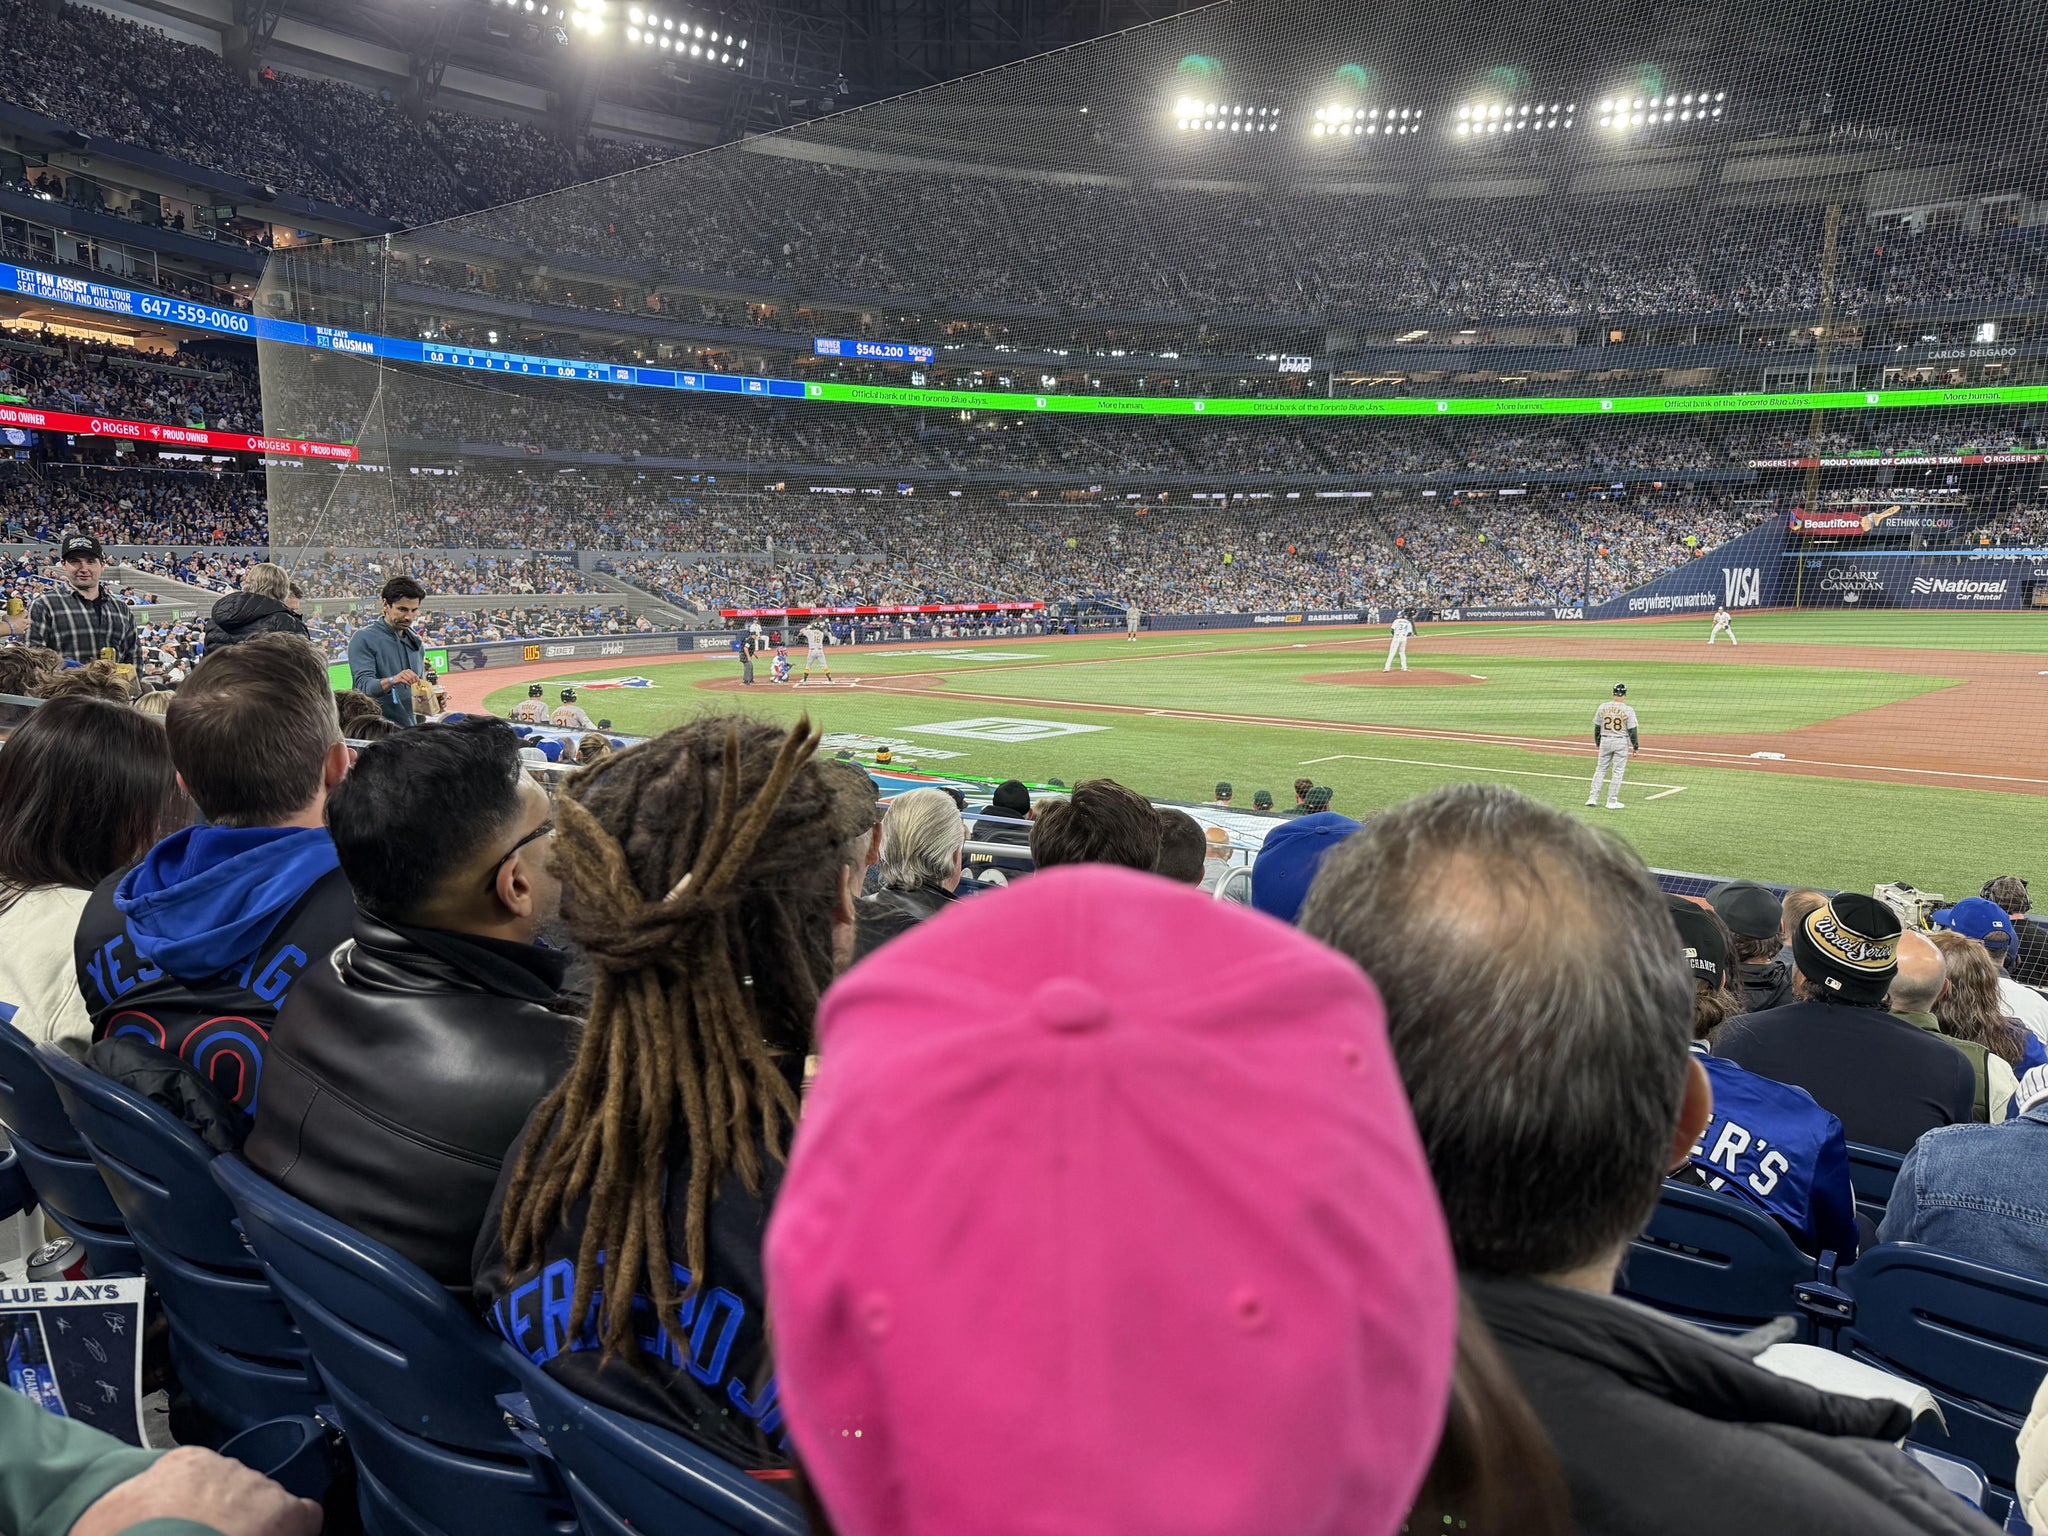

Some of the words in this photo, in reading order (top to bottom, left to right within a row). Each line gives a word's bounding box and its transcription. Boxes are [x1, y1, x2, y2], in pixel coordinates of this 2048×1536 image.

[16, 269, 35, 282] TEXT
[36, 272, 54, 287] FAN
[56, 276, 88, 294] ASSIST
[90, 286, 109, 298] WITH
[110, 290, 132, 302] YOUR
[18, 281, 36, 294] SEAT
[37, 285, 74, 301] LOCATION
[76, 294, 92, 304] AND
[94, 296, 134, 312] QUESTION:
[141, 298, 248, 332] 647-559-0060
[316, 327, 332, 335] BLUE
[333, 329, 348, 338] JAYS
[332, 338, 373, 353] GAUSMAN
[1928, 350, 1965, 359] CARLOS
[1969, 348, 2016, 358] DELGADO
[431, 352, 444, 362] 0.0
[452, 355, 458, 364] 0
[468, 356, 474, 366] 0
[486, 359, 492, 368] 0
[504, 361, 510, 370] 0
[522, 363, 528, 372] 0
[558, 367, 575, 376] 0.00
[1278, 360, 1311, 372] KPMG
[808, 386, 822, 396] TD
[851, 390, 878, 399] Official
[921, 394, 950, 403] Toronto
[1969, 392, 2001, 400] human.
[1035, 398, 1046, 407] TD
[1866, 394, 1879, 404] TD
[1193, 401, 1205, 411] TD
[1436, 402, 1448, 412] TD
[1601, 400, 1613, 410] TD
[0, 410, 16, 422] OUD
[18, 413, 45, 426] OWNER
[103, 422, 140, 436] ROGERS
[163, 429, 185, 440] PROUD
[186, 432, 208, 444] OWNER
[258, 442, 290, 452] ROGERS
[310, 445, 330, 456] PROUD
[1804, 519, 1859, 528] BeautiTone
[1886, 519, 1920, 527] RETHINK
[1921, 518, 1953, 527] COLOUR
[1722, 567, 1760, 607] VISA
[1629, 593, 1670, 613] everywhere
[1671, 596, 1684, 611] you
[1684, 593, 1700, 607] want
[1708, 591, 1716, 606] be
[1552, 608, 1583, 619] VISA
[708, 638, 730, 646] clover
[1604, 717, 1622, 731] 28
[1815, 916, 1852, 950] World
[1850, 941, 1893, 962] Series
[55, 1284, 120, 1301] JAYS
